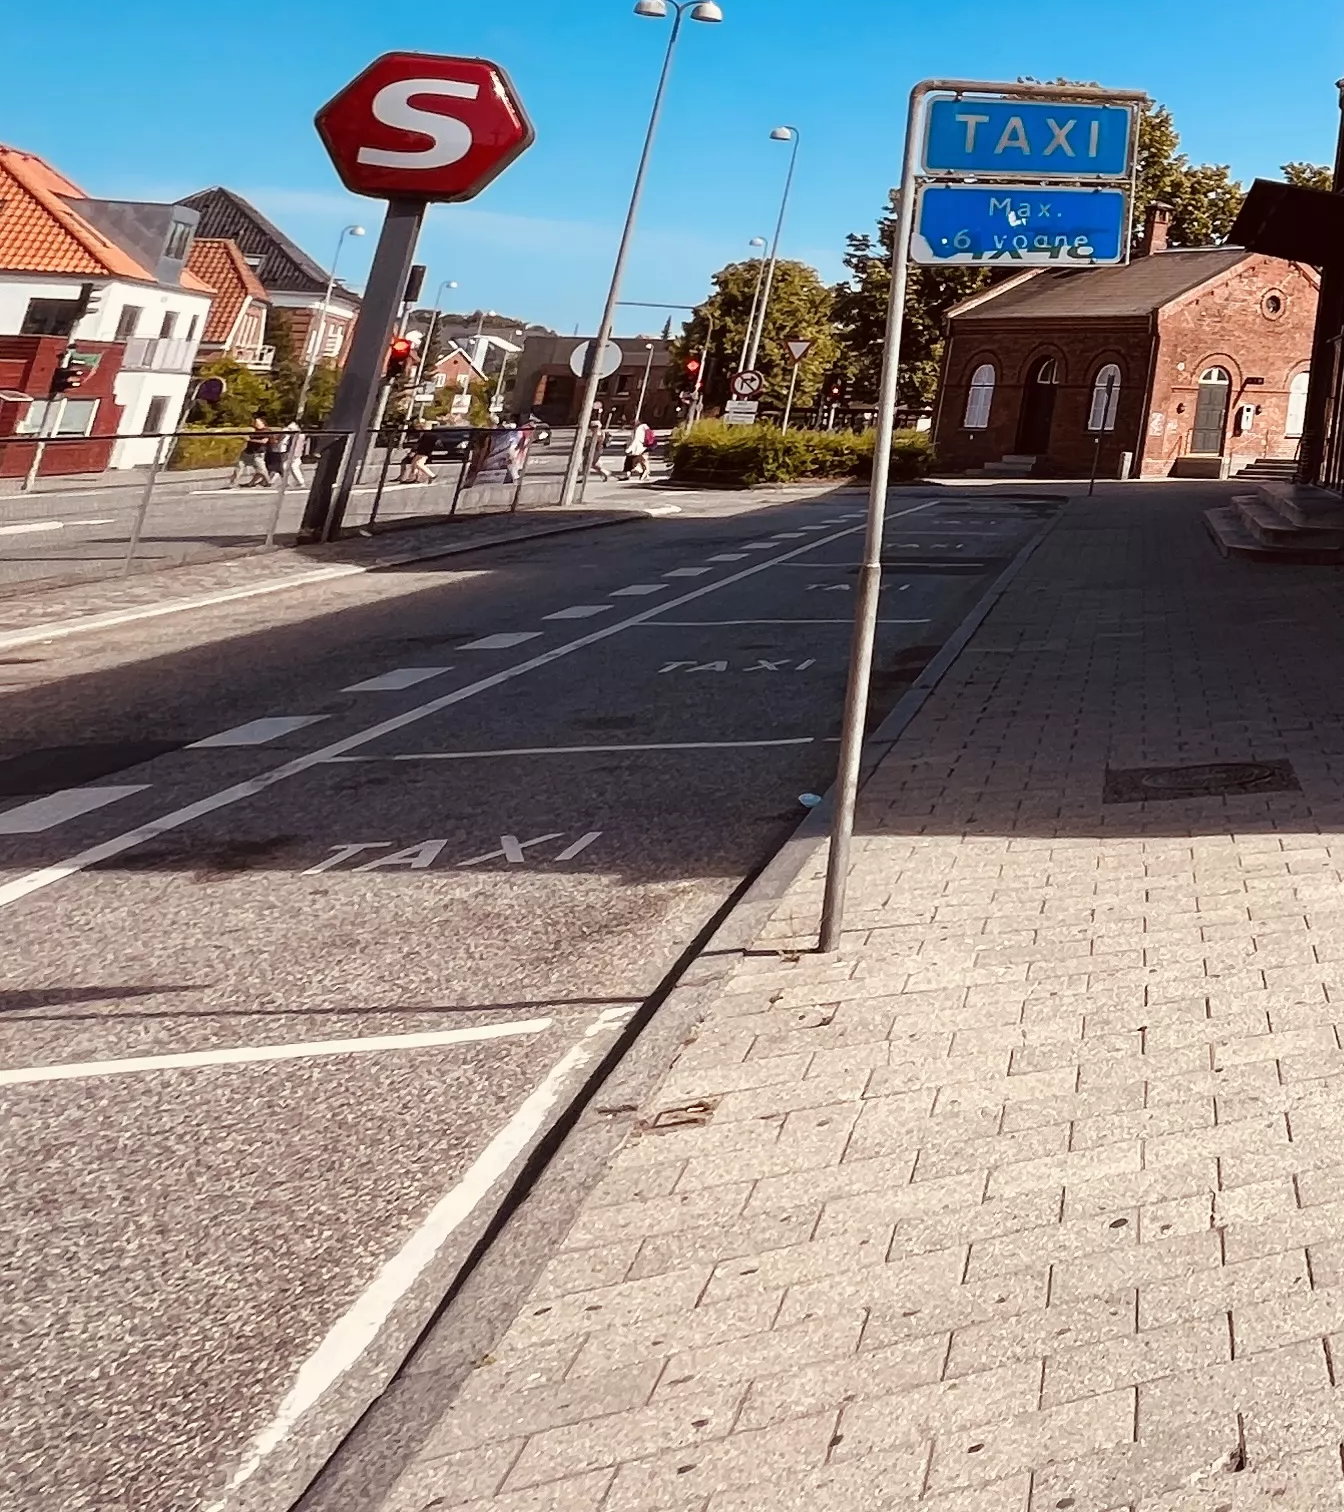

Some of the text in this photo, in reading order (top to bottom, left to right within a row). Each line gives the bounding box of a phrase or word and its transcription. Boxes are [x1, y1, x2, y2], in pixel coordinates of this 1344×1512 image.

[356, 78, 480, 170] S
[955, 114, 1100, 158] TAXI
[988, 197, 1063, 218] Max.
[953, 229, 971, 249] 6
[657, 658, 817, 674] TAXI
[299, 831, 603, 876] TAXI
